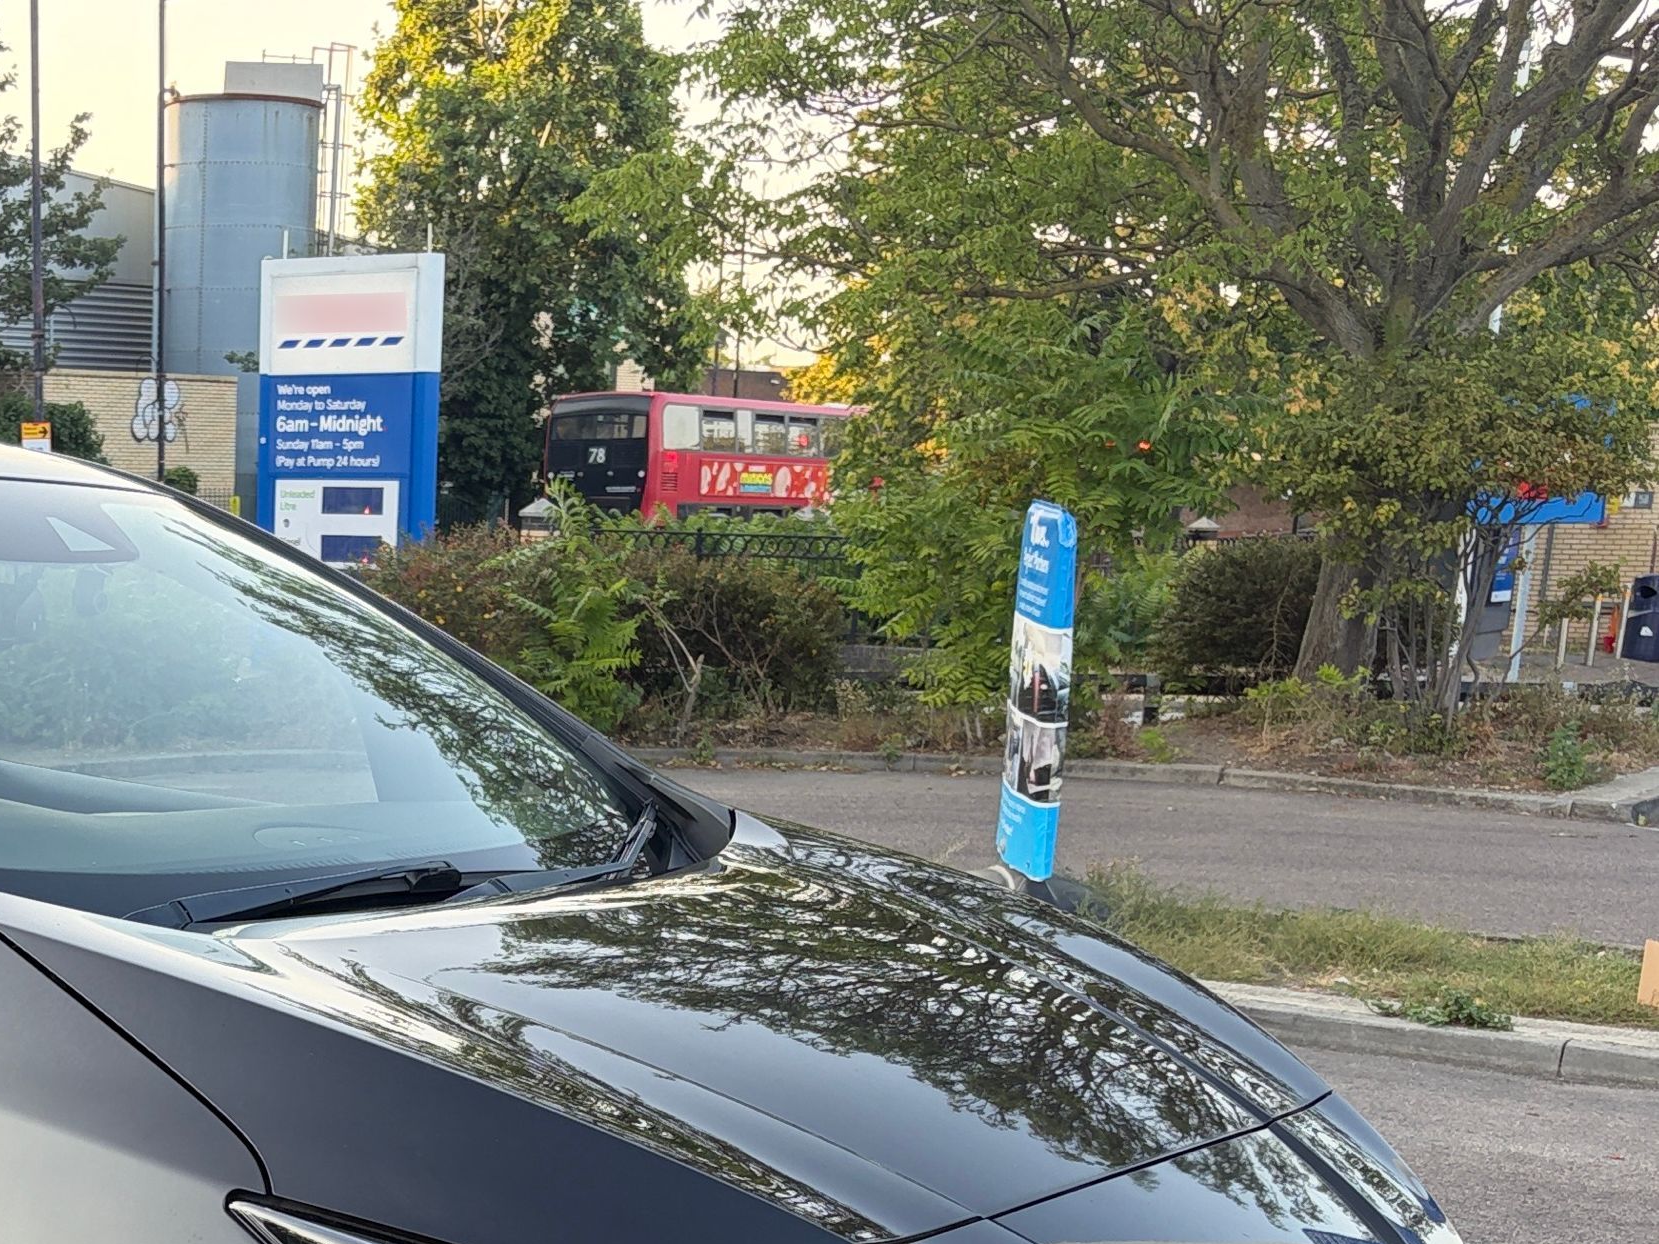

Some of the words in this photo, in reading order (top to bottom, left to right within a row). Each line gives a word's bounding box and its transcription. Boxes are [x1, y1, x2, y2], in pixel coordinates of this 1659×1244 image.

[276, 384, 305, 395] We're
[306, 385, 332, 397] open
[276, 399, 313, 413] Monday
[314, 399, 325, 411] to
[326, 398, 366, 412] Saturday
[276, 415, 309, 432] 6am
[319, 414, 383, 436] Midnight
[276, 438, 309, 452] Sunday
[310, 438, 334, 450] 11am
[342, 438, 365, 452] 5pm
[275, 454, 295, 469] (Pay
[296, 456, 306, 467] at
[307, 455, 335, 469] Pump
[336, 455, 348, 467] 24
[349, 454, 381, 468] hours)
[588, 447, 607, 464] 78
[280, 489, 316, 499] Unleaded
